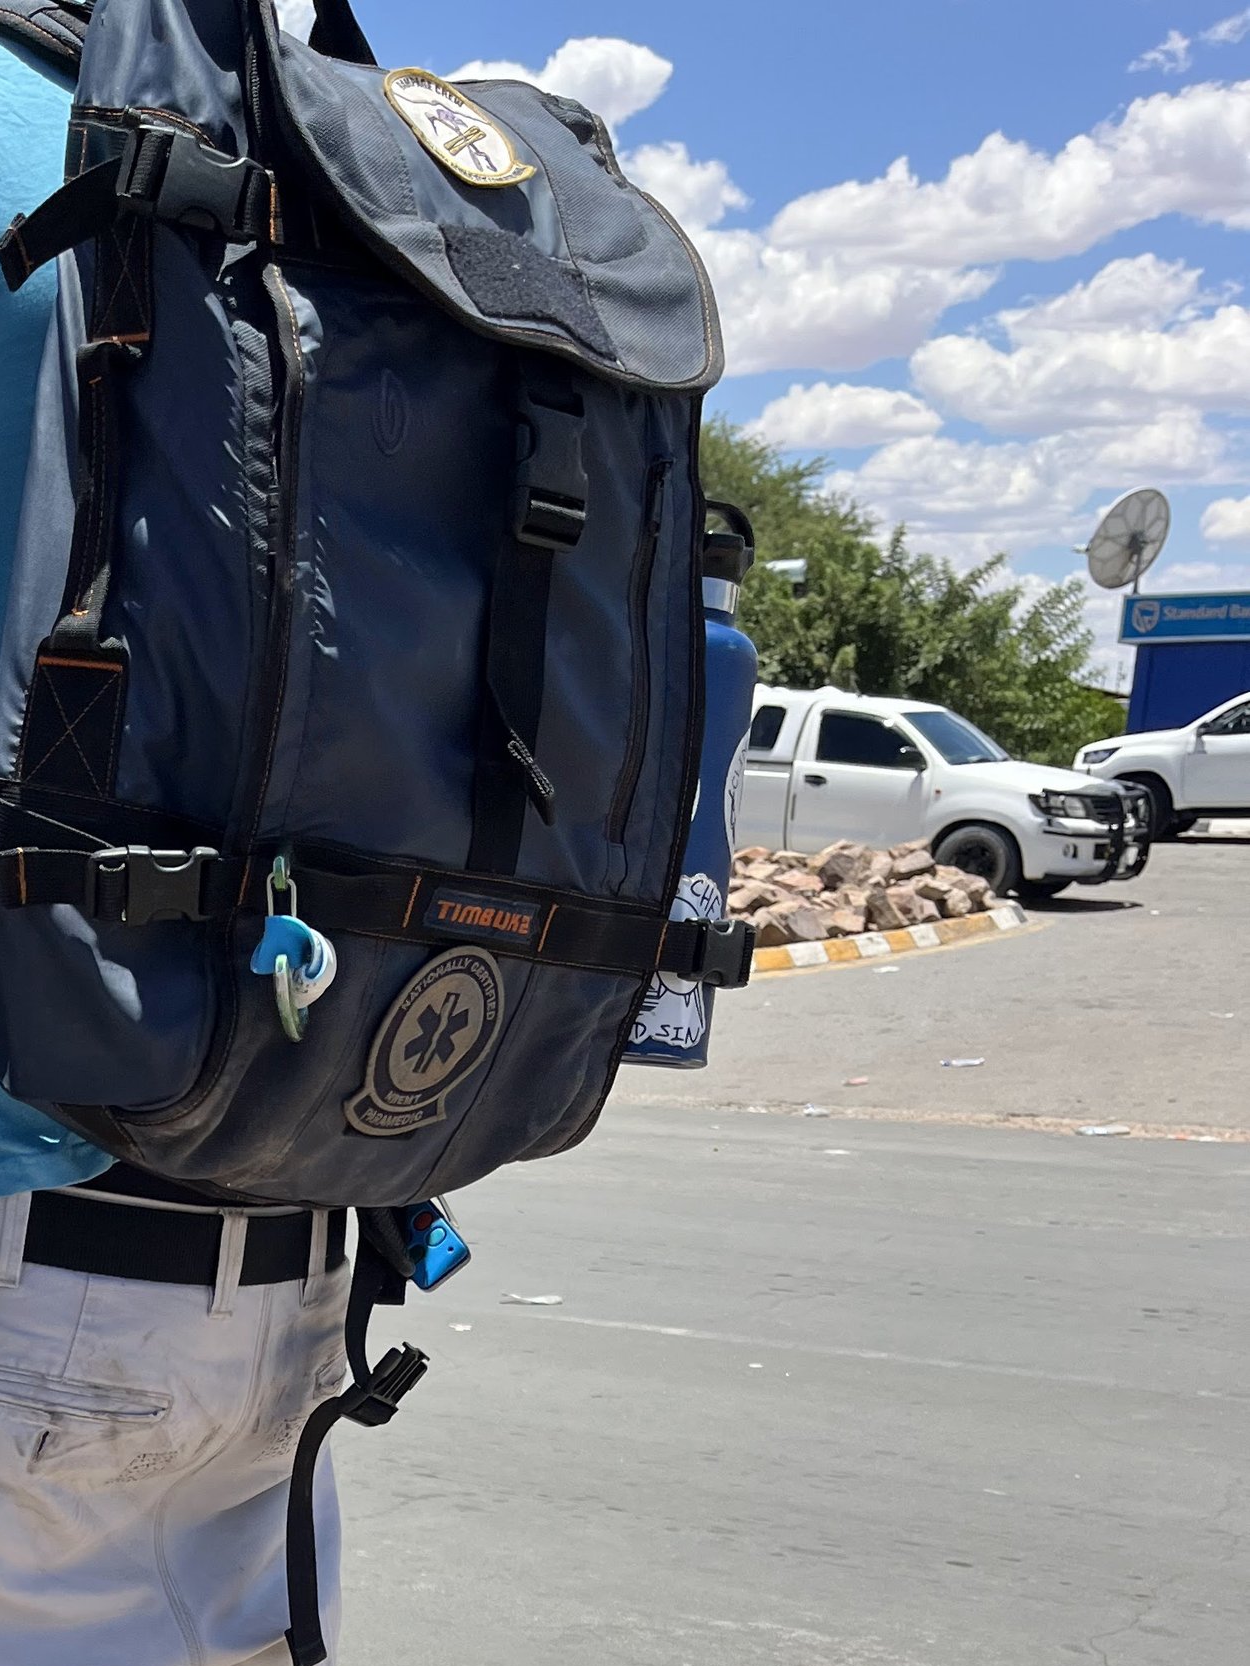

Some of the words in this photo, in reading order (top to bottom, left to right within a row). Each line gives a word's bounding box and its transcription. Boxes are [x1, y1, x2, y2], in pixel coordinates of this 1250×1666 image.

[437, 901, 533, 935] TIMBUK2
[400, 957, 472, 1011] NATIONALLY
[470, 962, 497, 1021] CERTIFIED
[655, 1024, 700, 1044] SIN
[361, 1107, 424, 1127] PARAMEDIC
